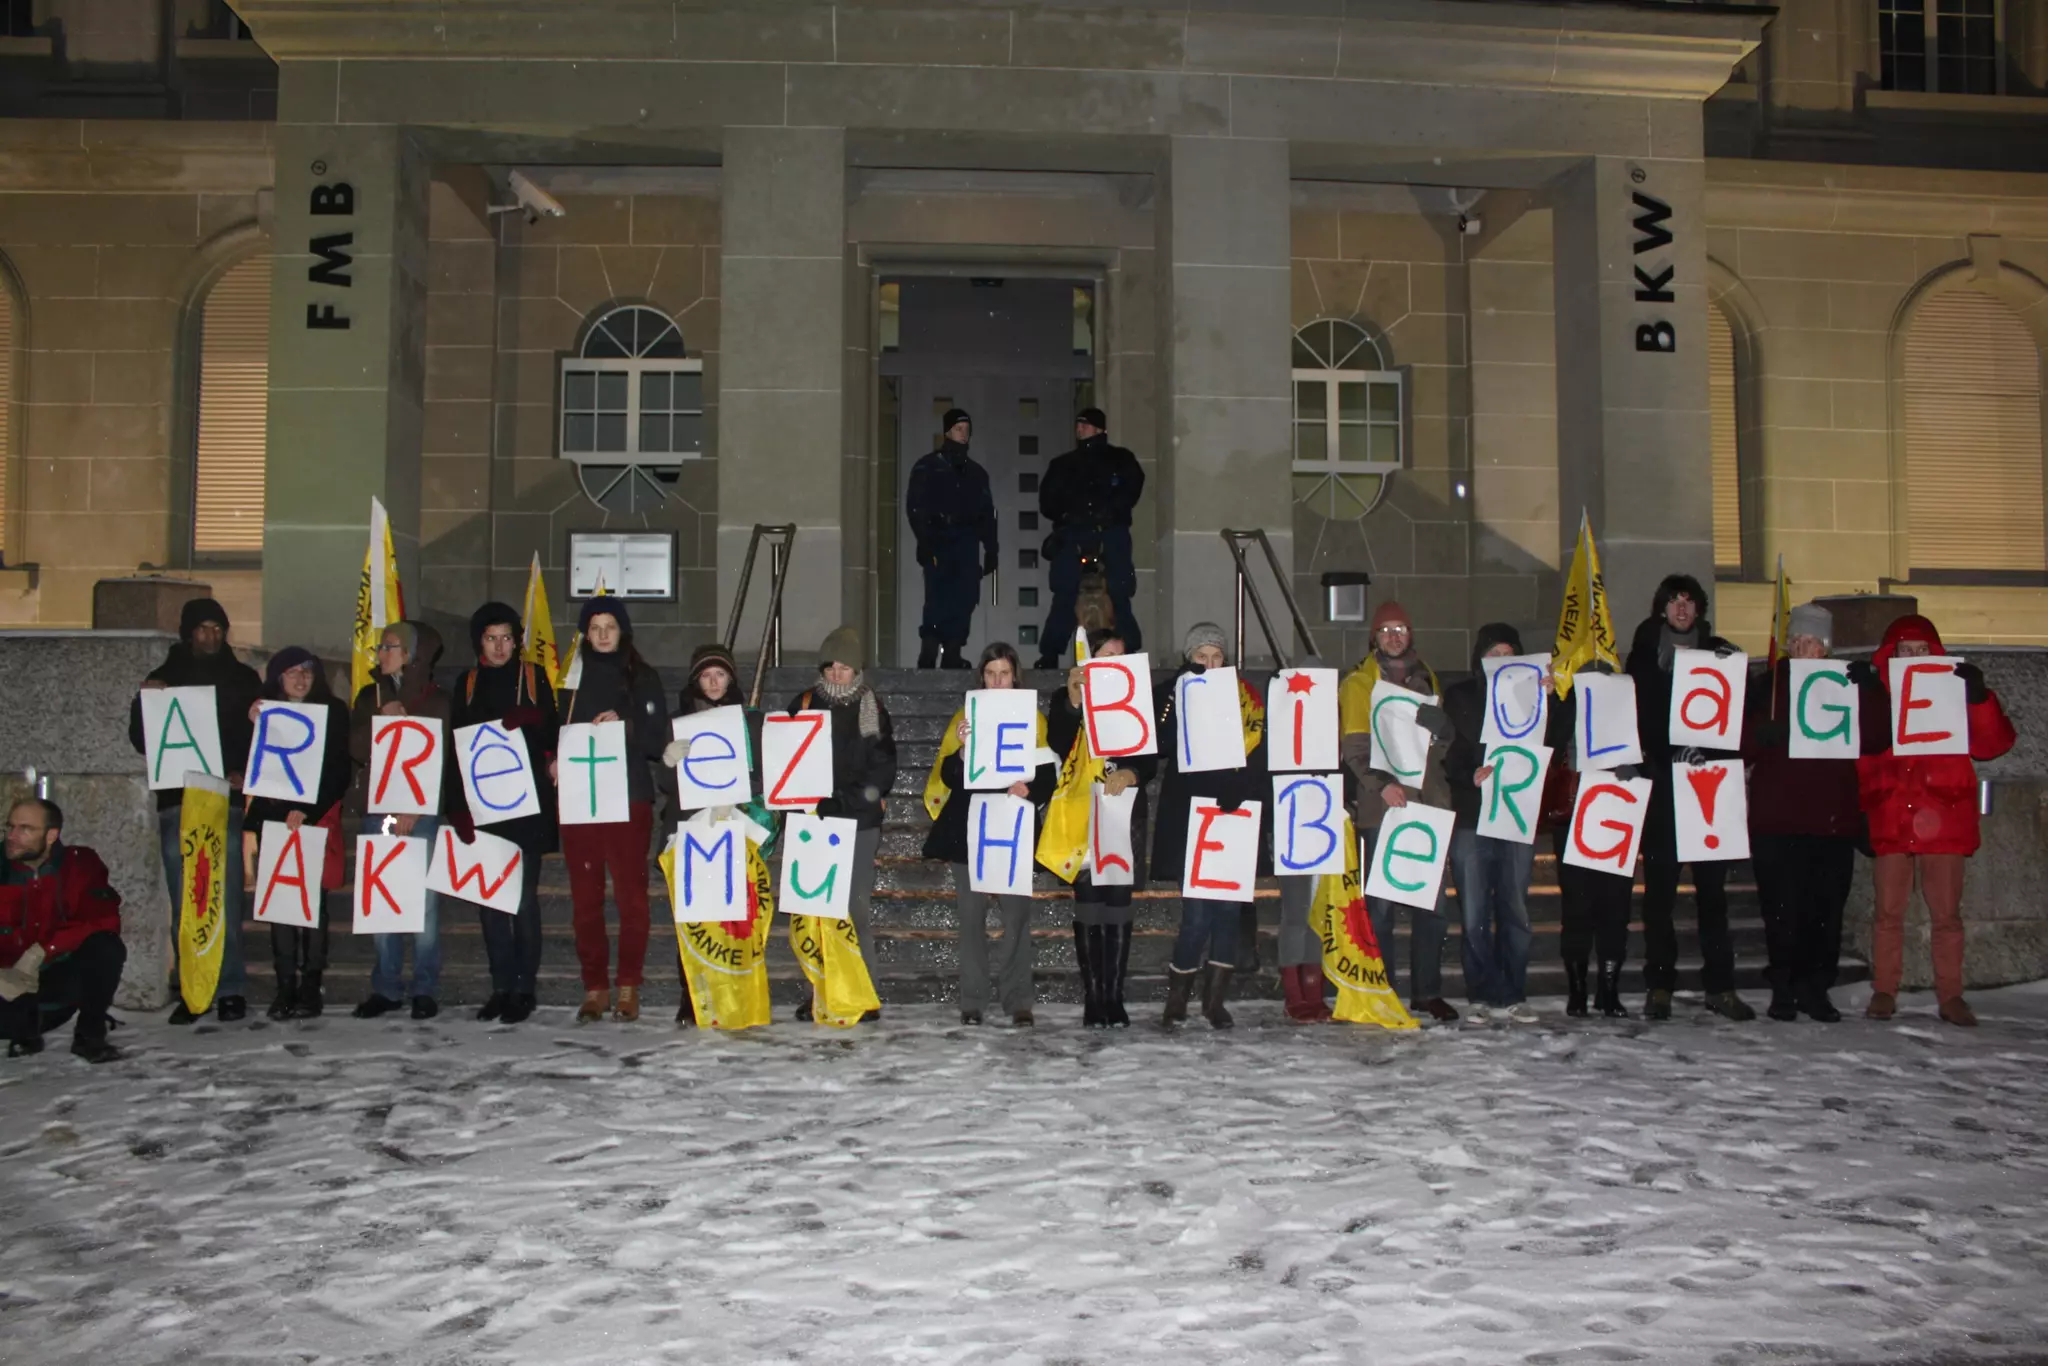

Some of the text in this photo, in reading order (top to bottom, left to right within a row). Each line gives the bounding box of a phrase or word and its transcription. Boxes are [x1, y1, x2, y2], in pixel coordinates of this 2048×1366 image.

[307, 182, 354, 329] FMB
[1632, 191, 1675, 352] BKW
[1336, 955, 1389, 986] DANK
